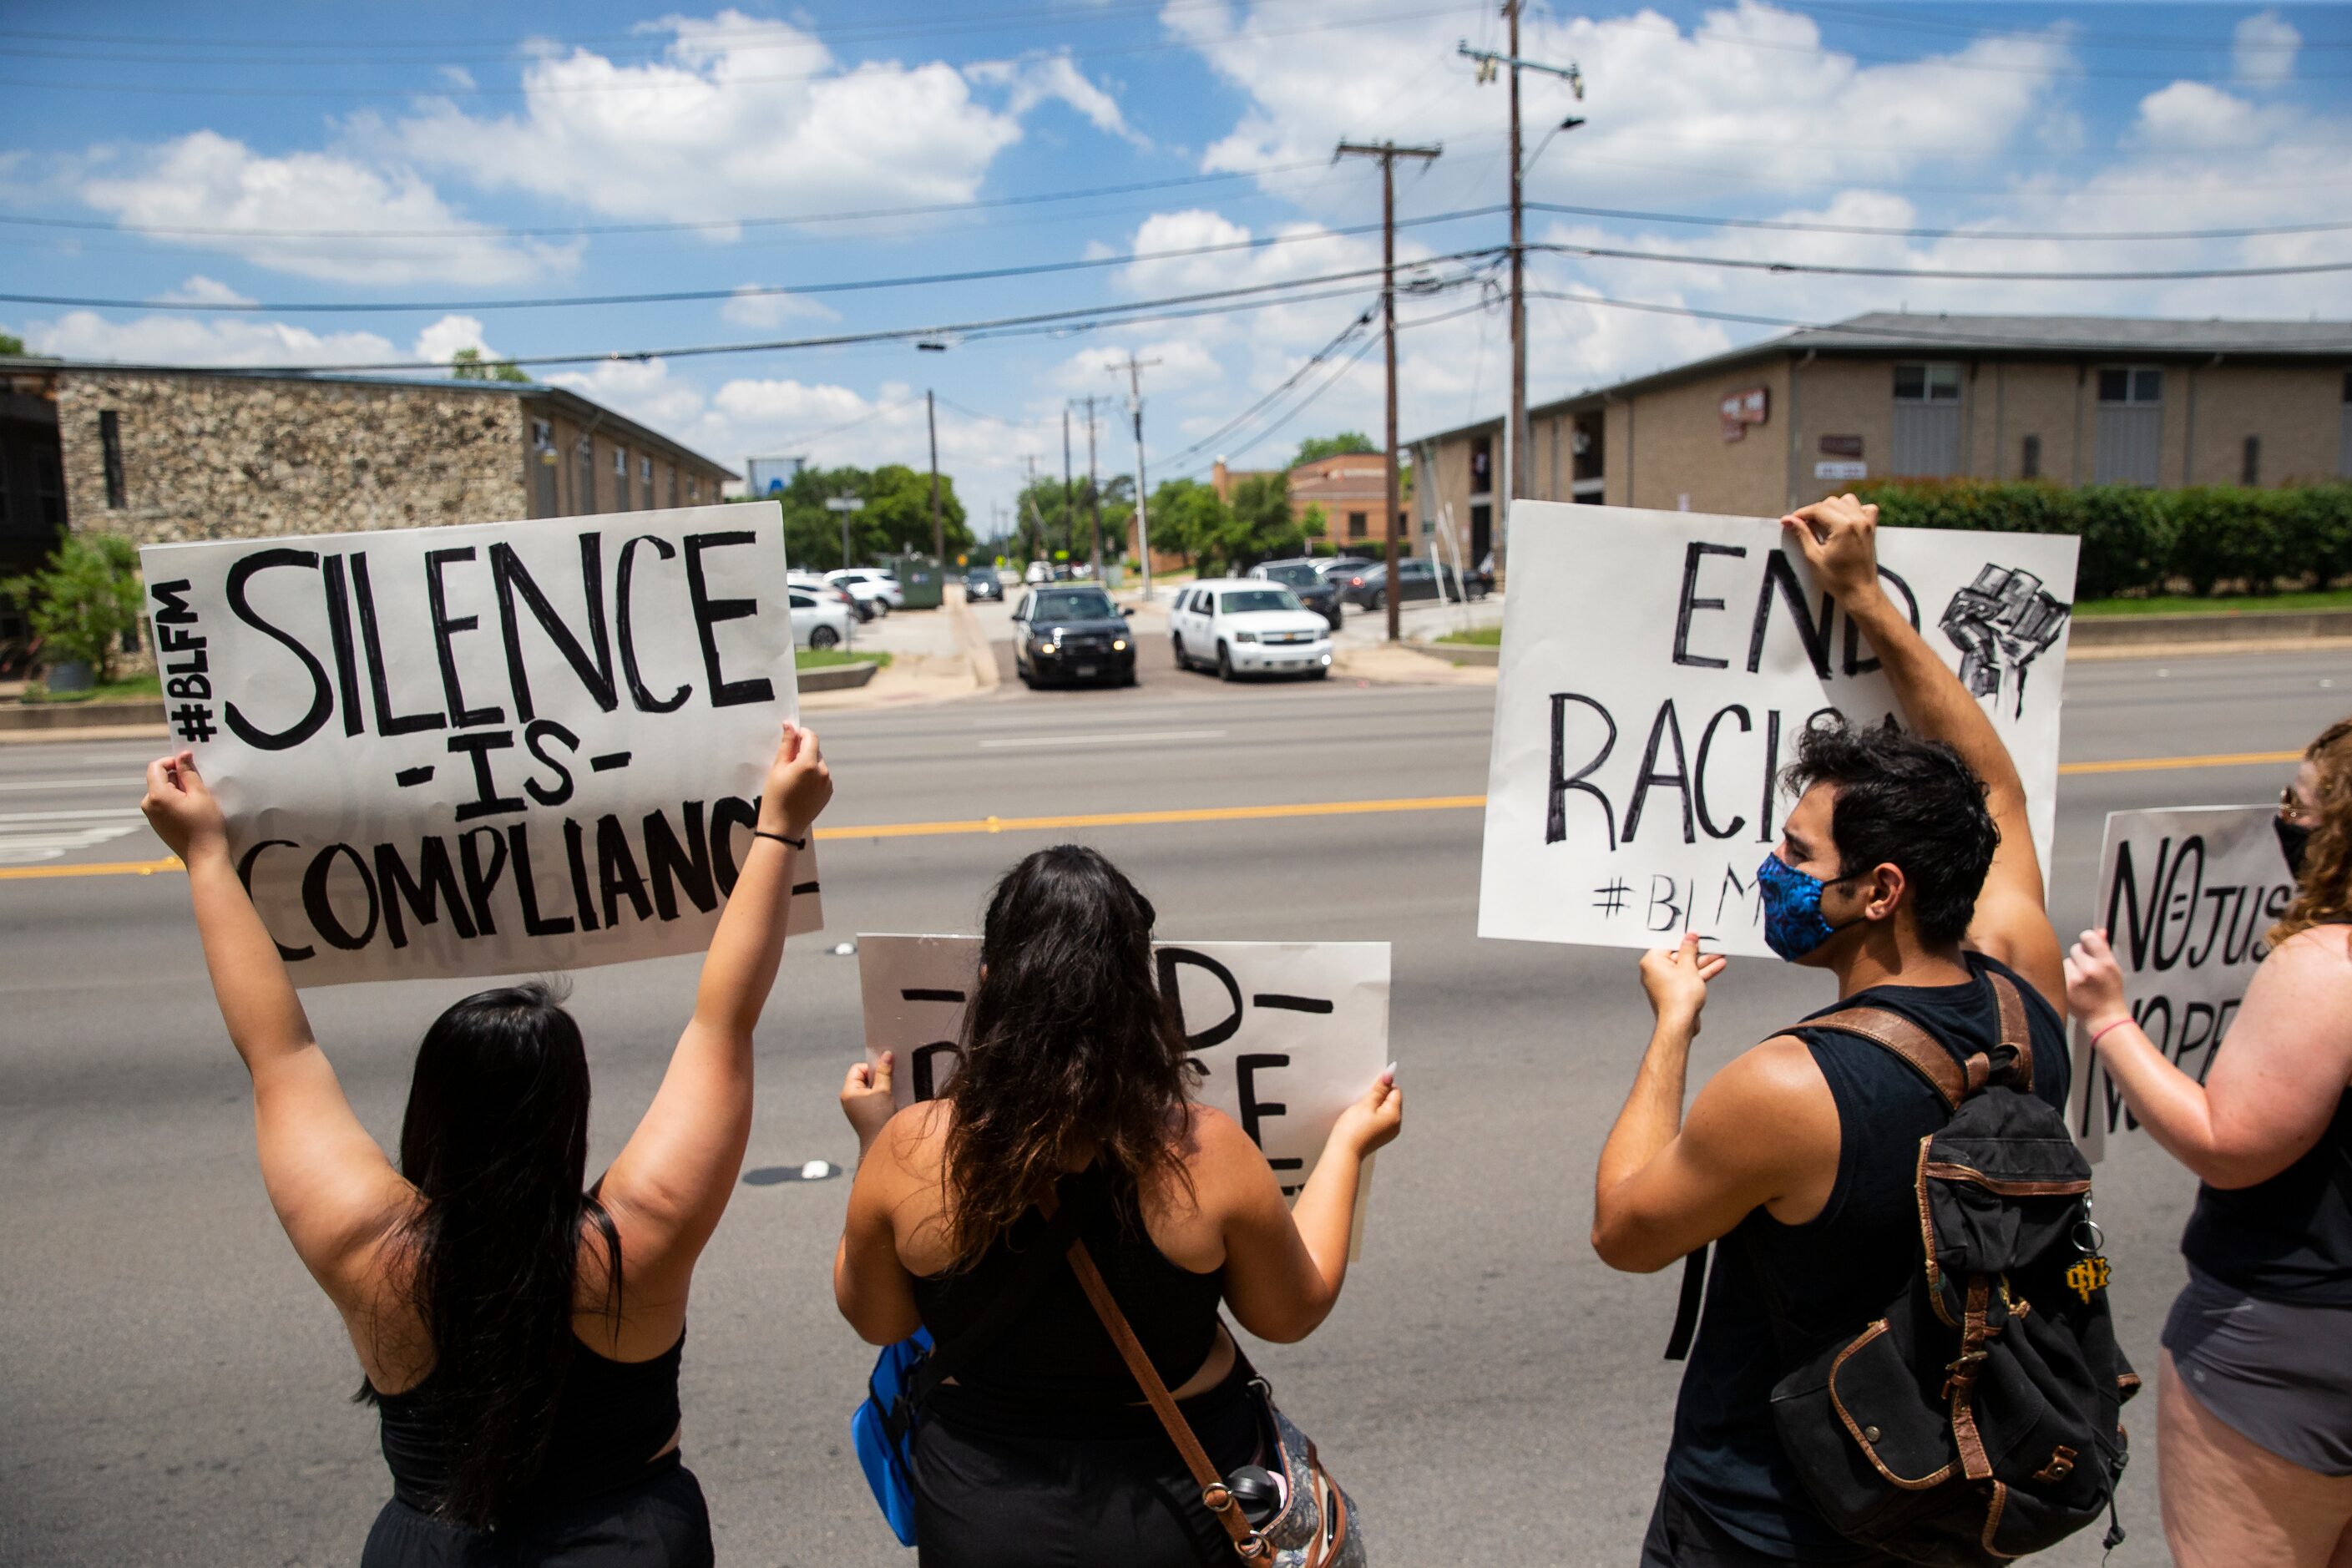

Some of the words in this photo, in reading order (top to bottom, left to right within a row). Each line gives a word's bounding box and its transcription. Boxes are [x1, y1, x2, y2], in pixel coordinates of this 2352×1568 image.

[151, 579, 217, 742] #BLFM
[225, 532, 775, 751] SILENCE
[1546, 692, 1901, 852] RACI
[1592, 862, 1764, 942] #BLM
